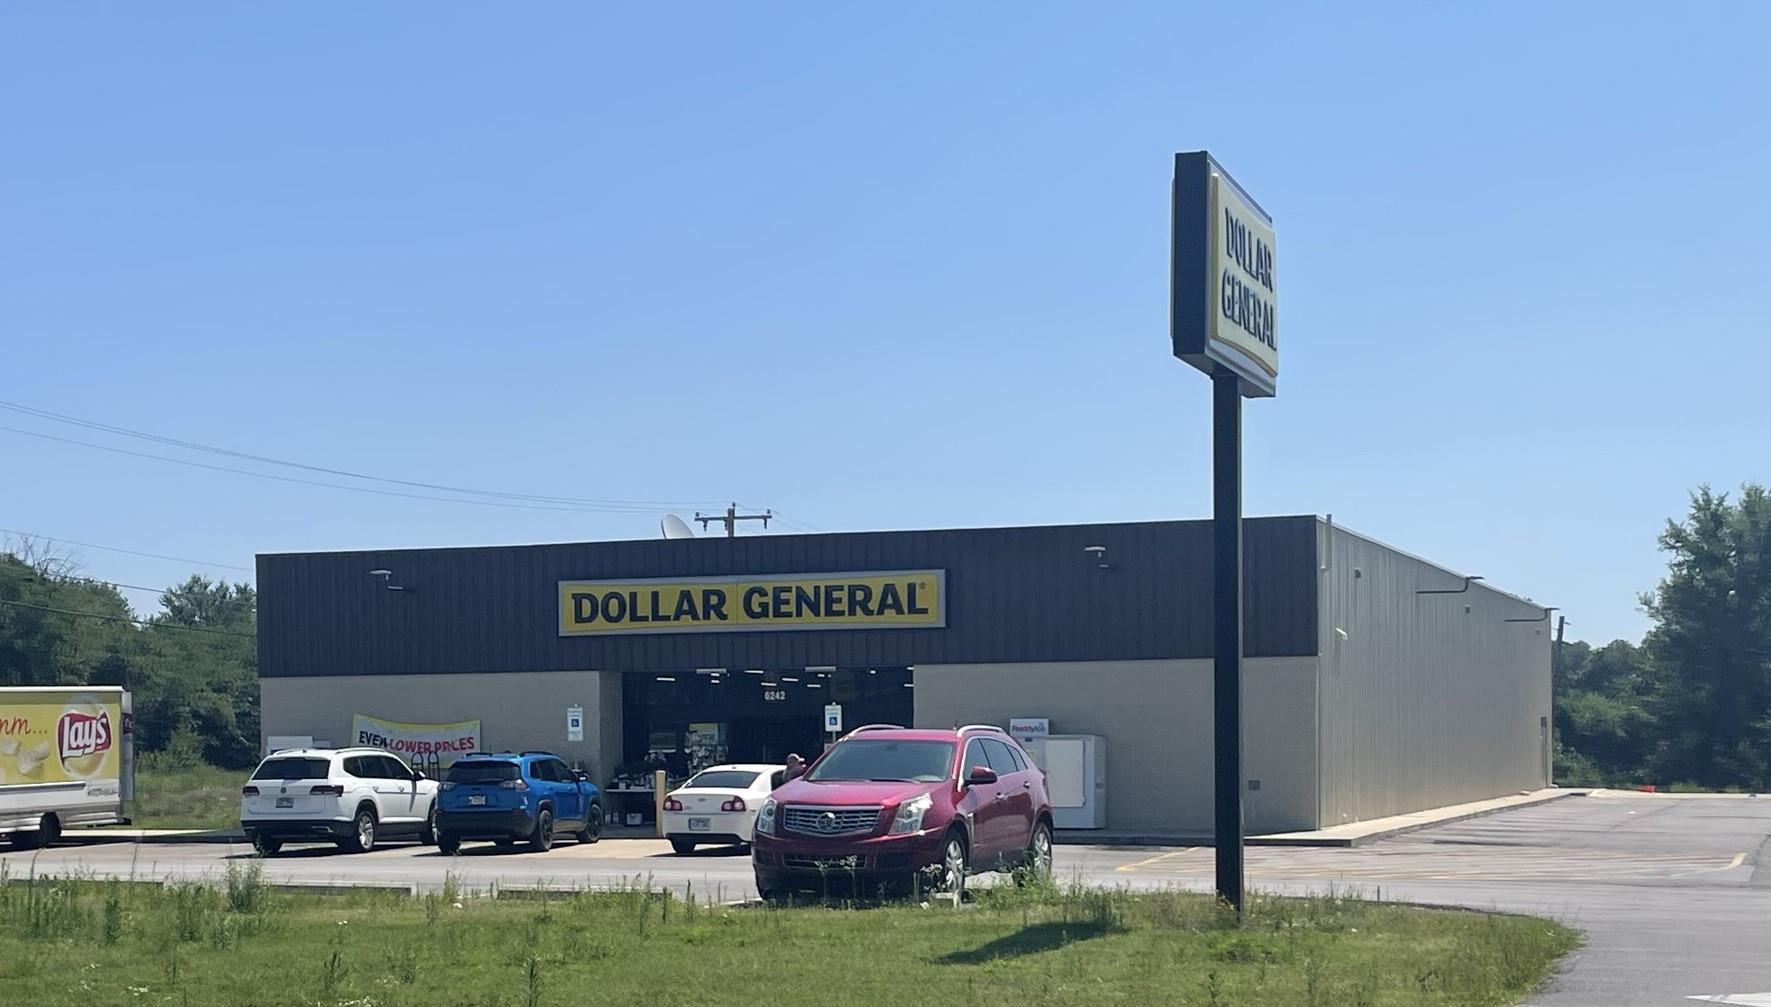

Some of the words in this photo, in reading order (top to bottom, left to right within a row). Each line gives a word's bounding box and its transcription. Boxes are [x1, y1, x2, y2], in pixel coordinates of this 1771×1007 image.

[1225, 206, 1273, 293] DOLLAR
[1221, 267, 1277, 351] GENERAL
[571, 588, 728, 623] DOLLAR
[742, 582, 929, 619] GENERAL
[764, 690, 786, 700] 6242
[359, 730, 388, 748] EVEN
[388, 739, 432, 753] LOWER
